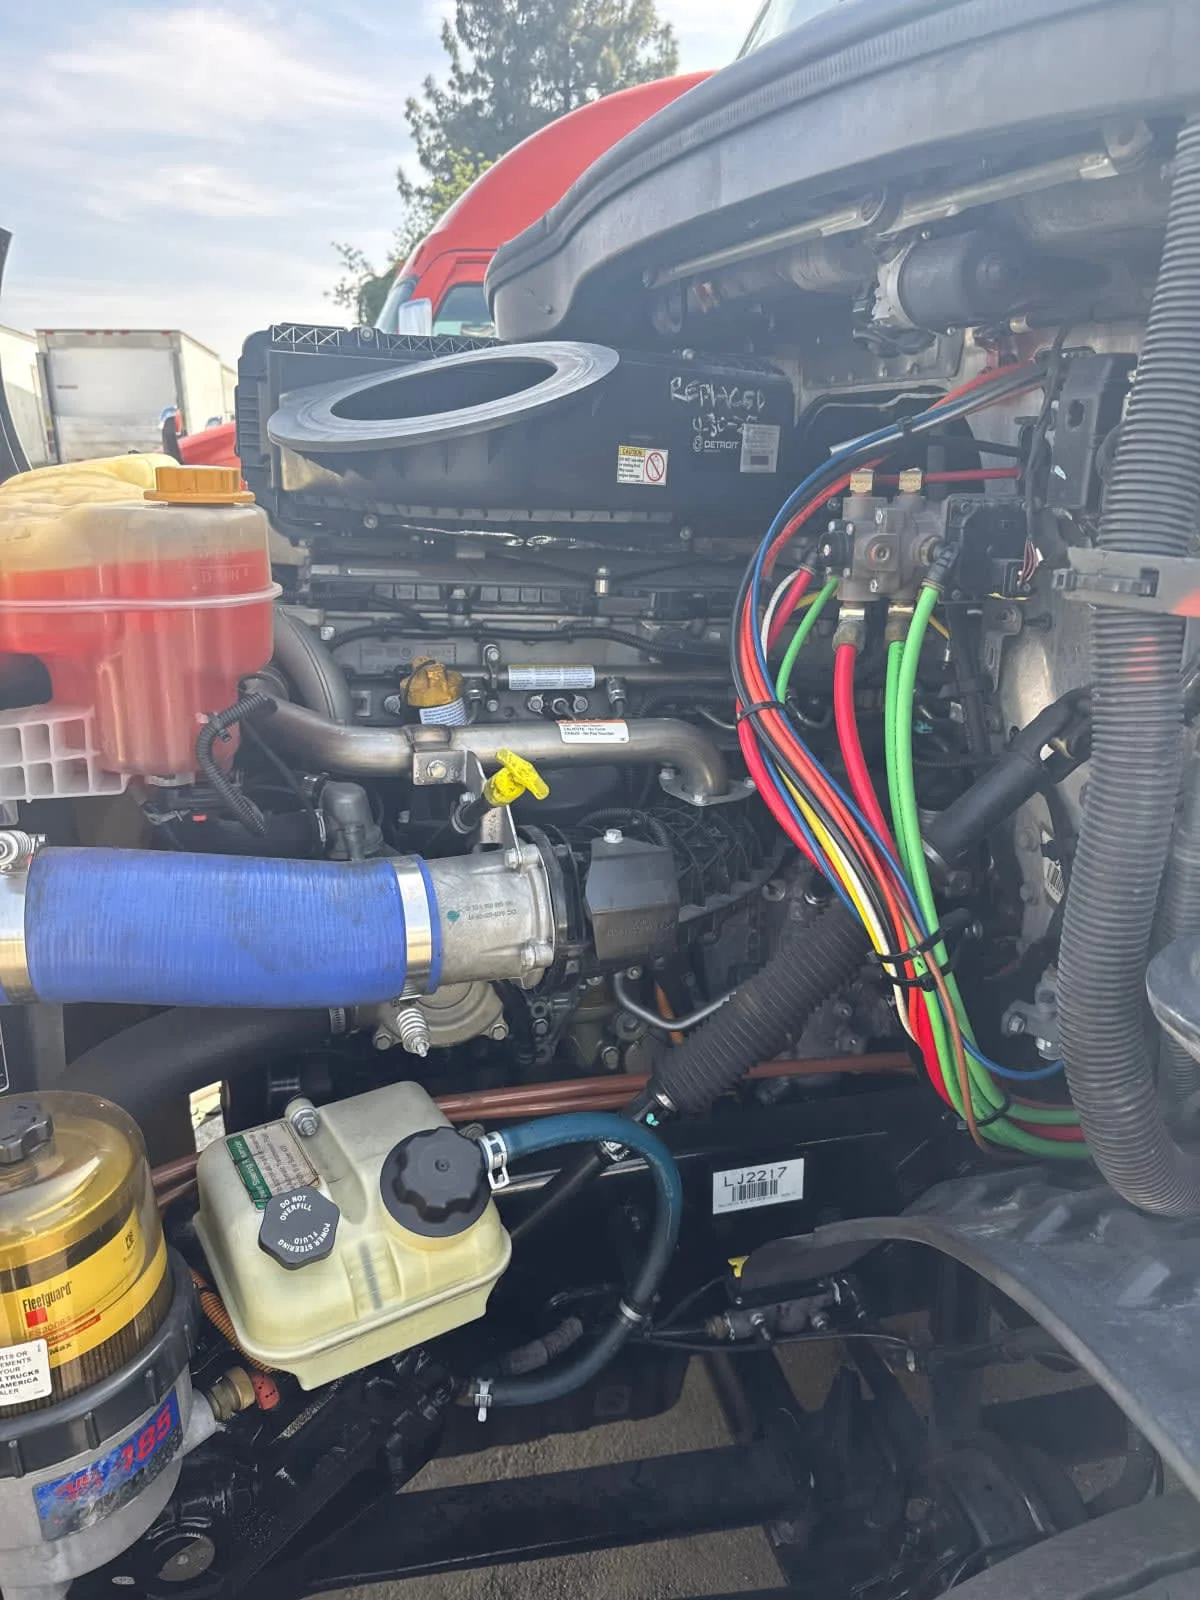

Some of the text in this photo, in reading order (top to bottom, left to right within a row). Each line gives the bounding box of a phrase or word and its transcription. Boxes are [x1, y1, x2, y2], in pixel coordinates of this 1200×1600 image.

[704, 440, 739, 449] DETROIT
[724, 1166, 787, 1187] LJ2217
[280, 1199, 290, 1209] DO
[280, 1203, 312, 1221] OVERFILL
[278, 1222, 331, 1253] POWER STEERING
[294, 1231, 318, 1245] FLUID
[22, 1281, 73, 1313] Fleetguard
[5, 1369, 40, 1381] TRUCKS
[0, 1376, 39, 1389] AMERICA
